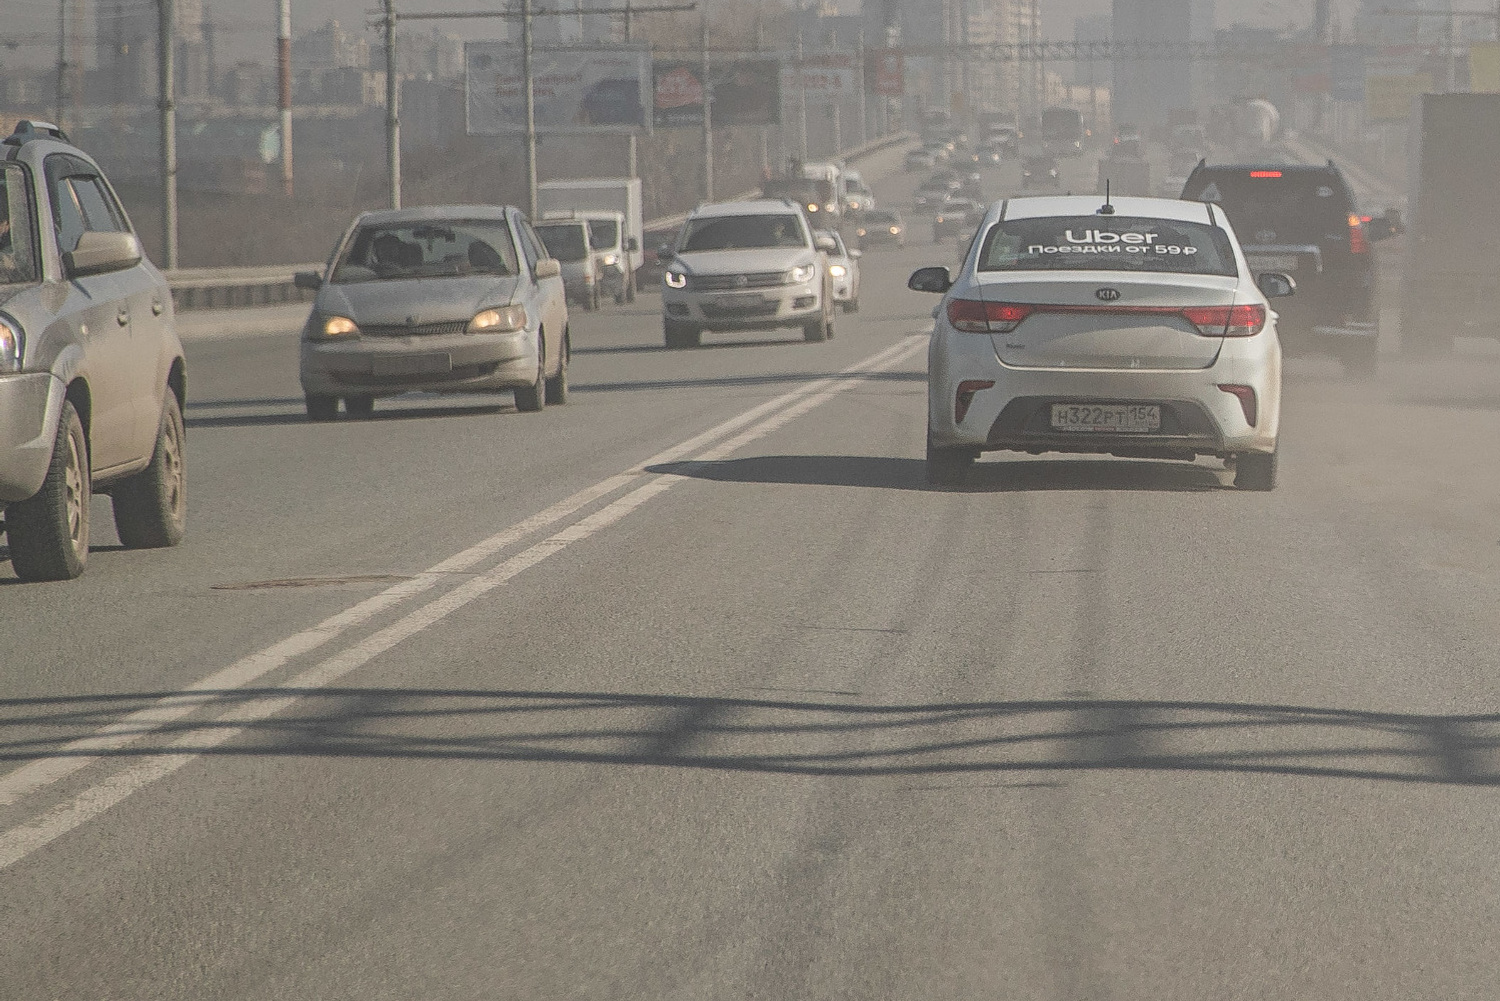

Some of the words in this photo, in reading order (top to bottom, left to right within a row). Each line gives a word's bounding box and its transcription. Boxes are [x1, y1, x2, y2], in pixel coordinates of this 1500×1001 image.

[1065, 229, 1158, 244] Uber
[1028, 244, 1121, 255] Поездки
[1125, 245, 1151, 254] от
